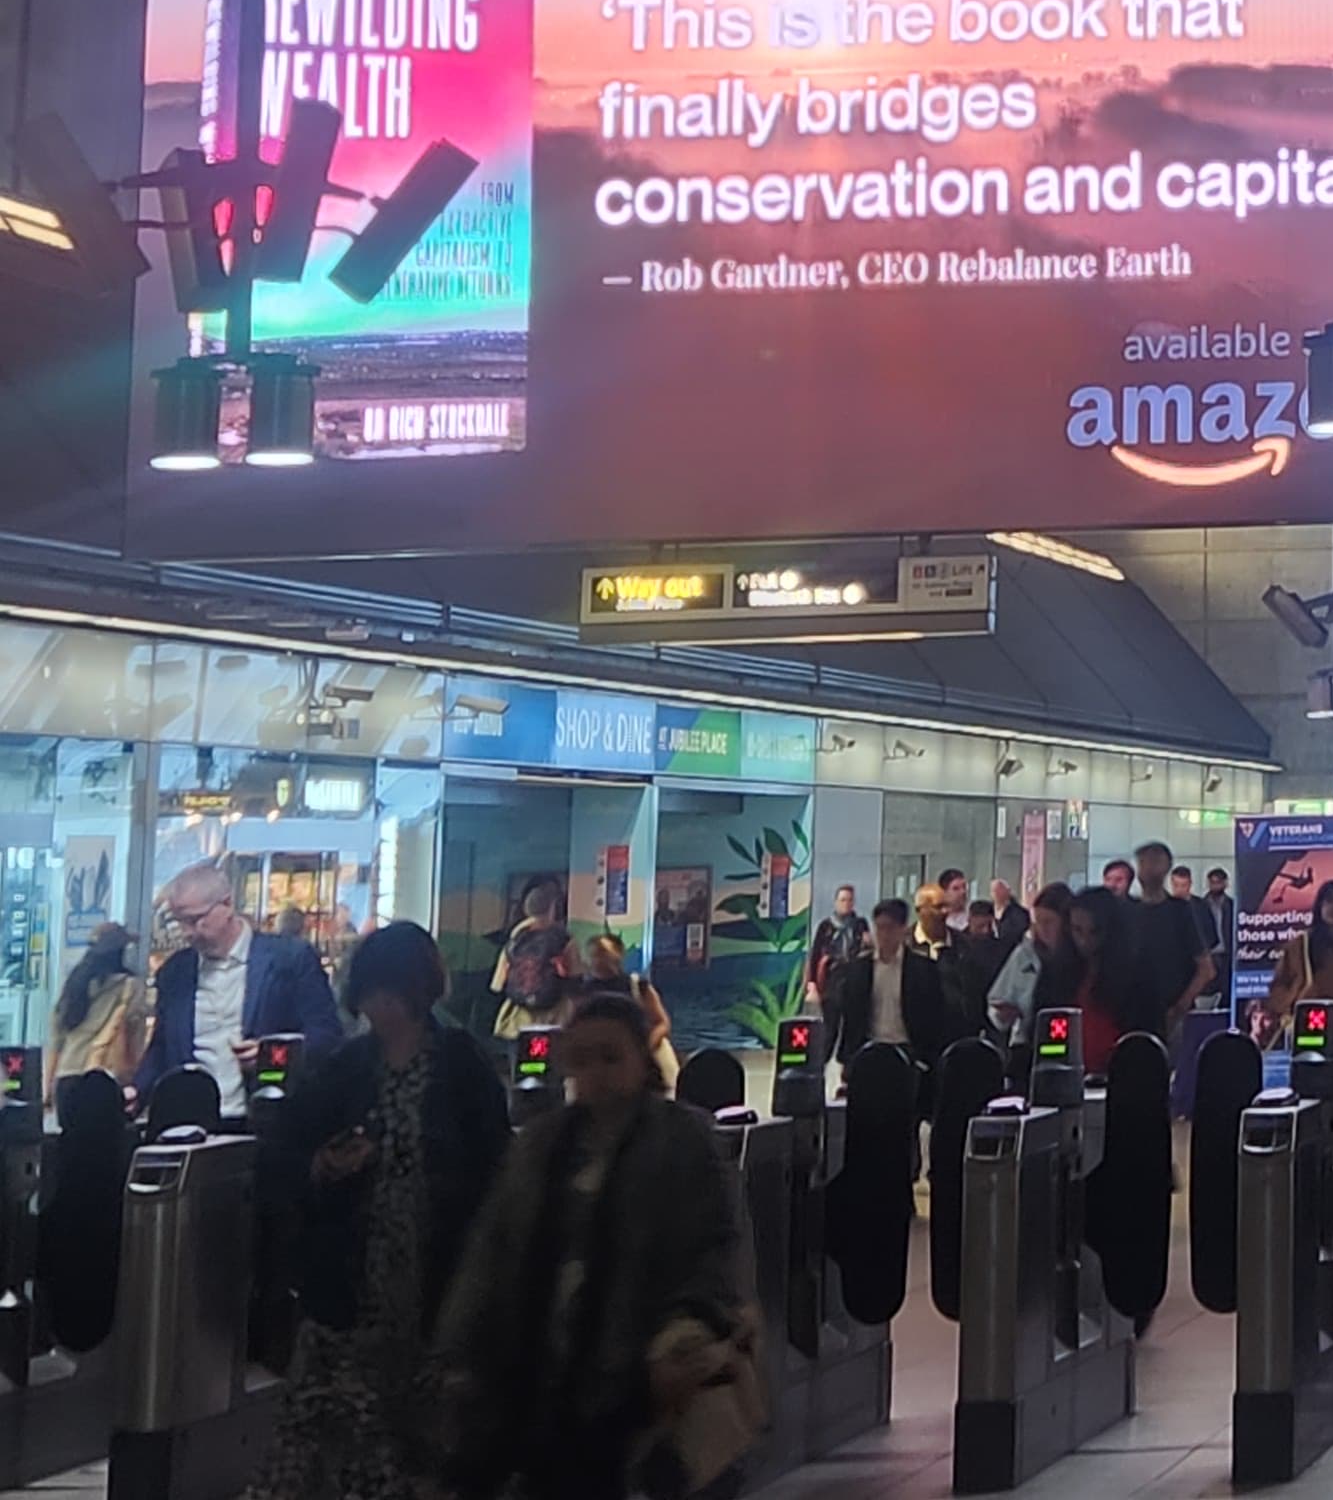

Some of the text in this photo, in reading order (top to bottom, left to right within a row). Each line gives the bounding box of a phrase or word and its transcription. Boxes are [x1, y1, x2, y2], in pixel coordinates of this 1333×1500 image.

[598, 73, 1038, 147] finally bridges
[594, 157, 1009, 227] conservation
[1025, 151, 1142, 212] and
[642, 258, 703, 293] Rob
[710, 250, 850, 291] Gardner,
[857, 250, 928, 284] CEO
[938, 245, 1097, 284] Rebalance
[1106, 243, 1192, 280] Earth
[1123, 321, 1291, 363] available
[616, 575, 704, 602] Way out
[555, 706, 652, 755] SHOP & DINE
[668, 729, 701, 753] JUBILEE
[701, 731, 728, 756] PLACE
[1268, 823, 1323, 836] VETERANS
[1237, 928, 1275, 942] those
[1238, 910, 1314, 927] Supporting
